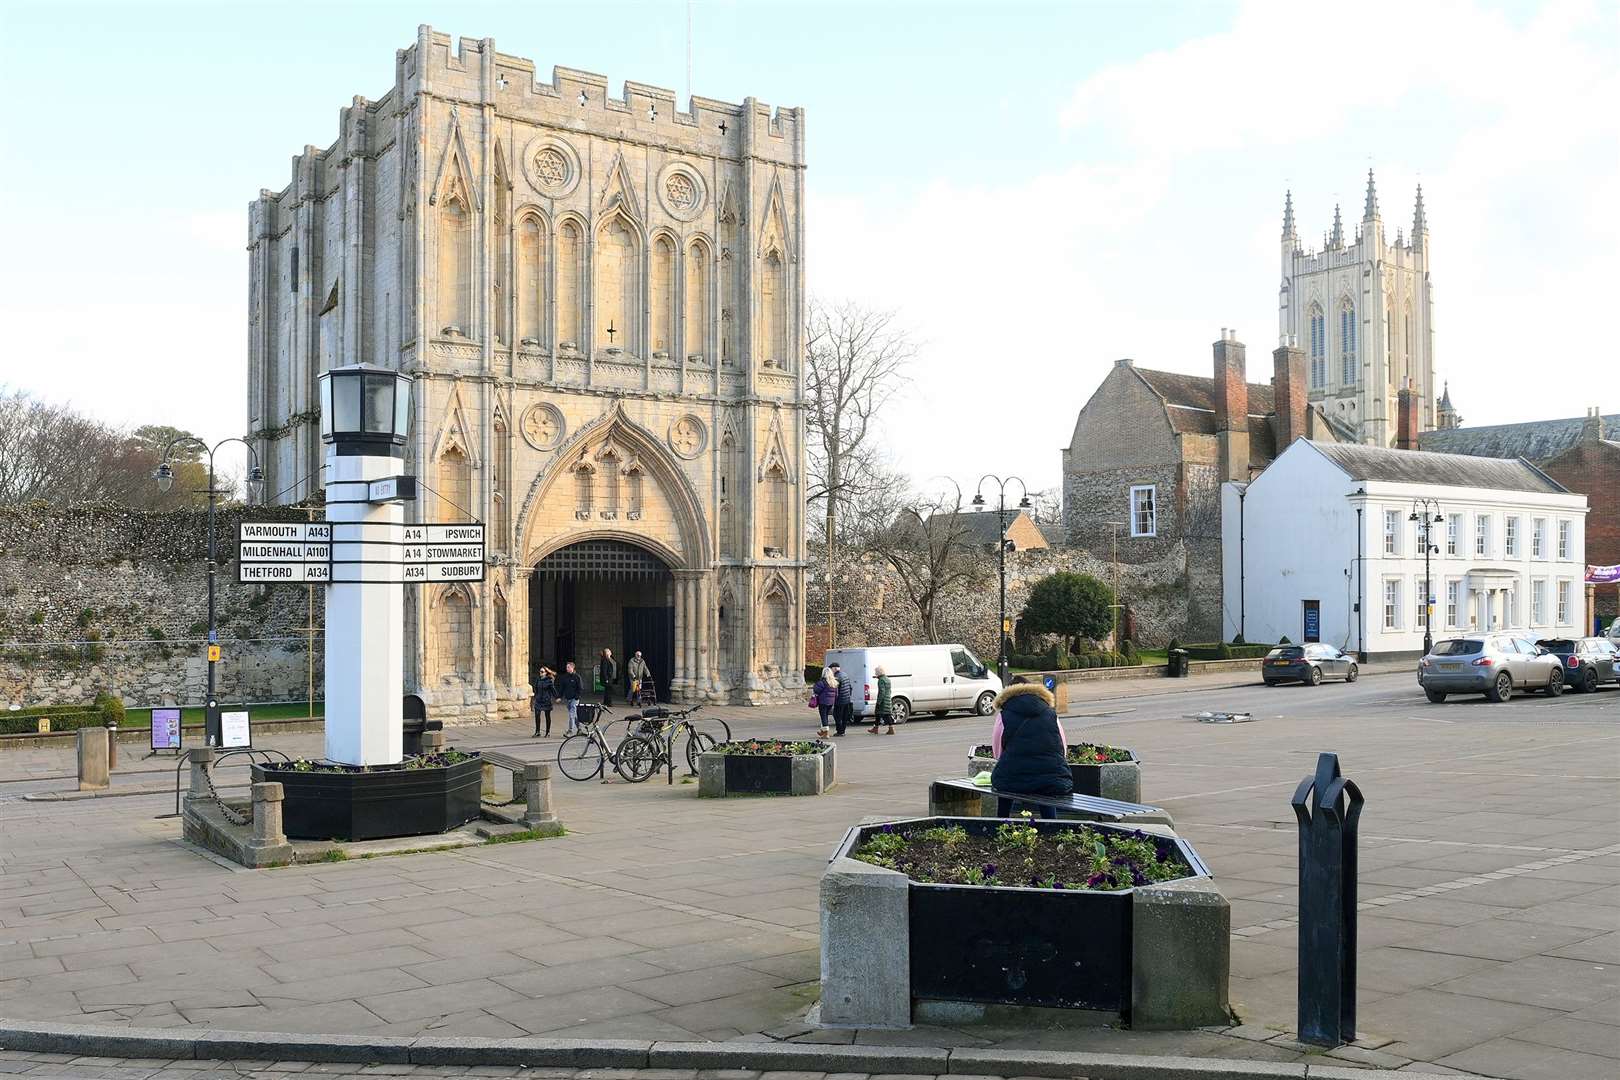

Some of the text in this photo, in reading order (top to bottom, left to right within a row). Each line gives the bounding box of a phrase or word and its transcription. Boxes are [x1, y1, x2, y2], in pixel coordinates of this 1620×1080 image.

[244, 526, 329, 538] YARMOUTH A143
[445, 529, 481, 539] IPSWICH
[242, 546, 329, 557] MILDENHALL A1101
[427, 547, 482, 558] STOWMARKET
[243, 567, 328, 578] THETFORD A134
[405, 566, 481, 577] A134 SUDBURY
